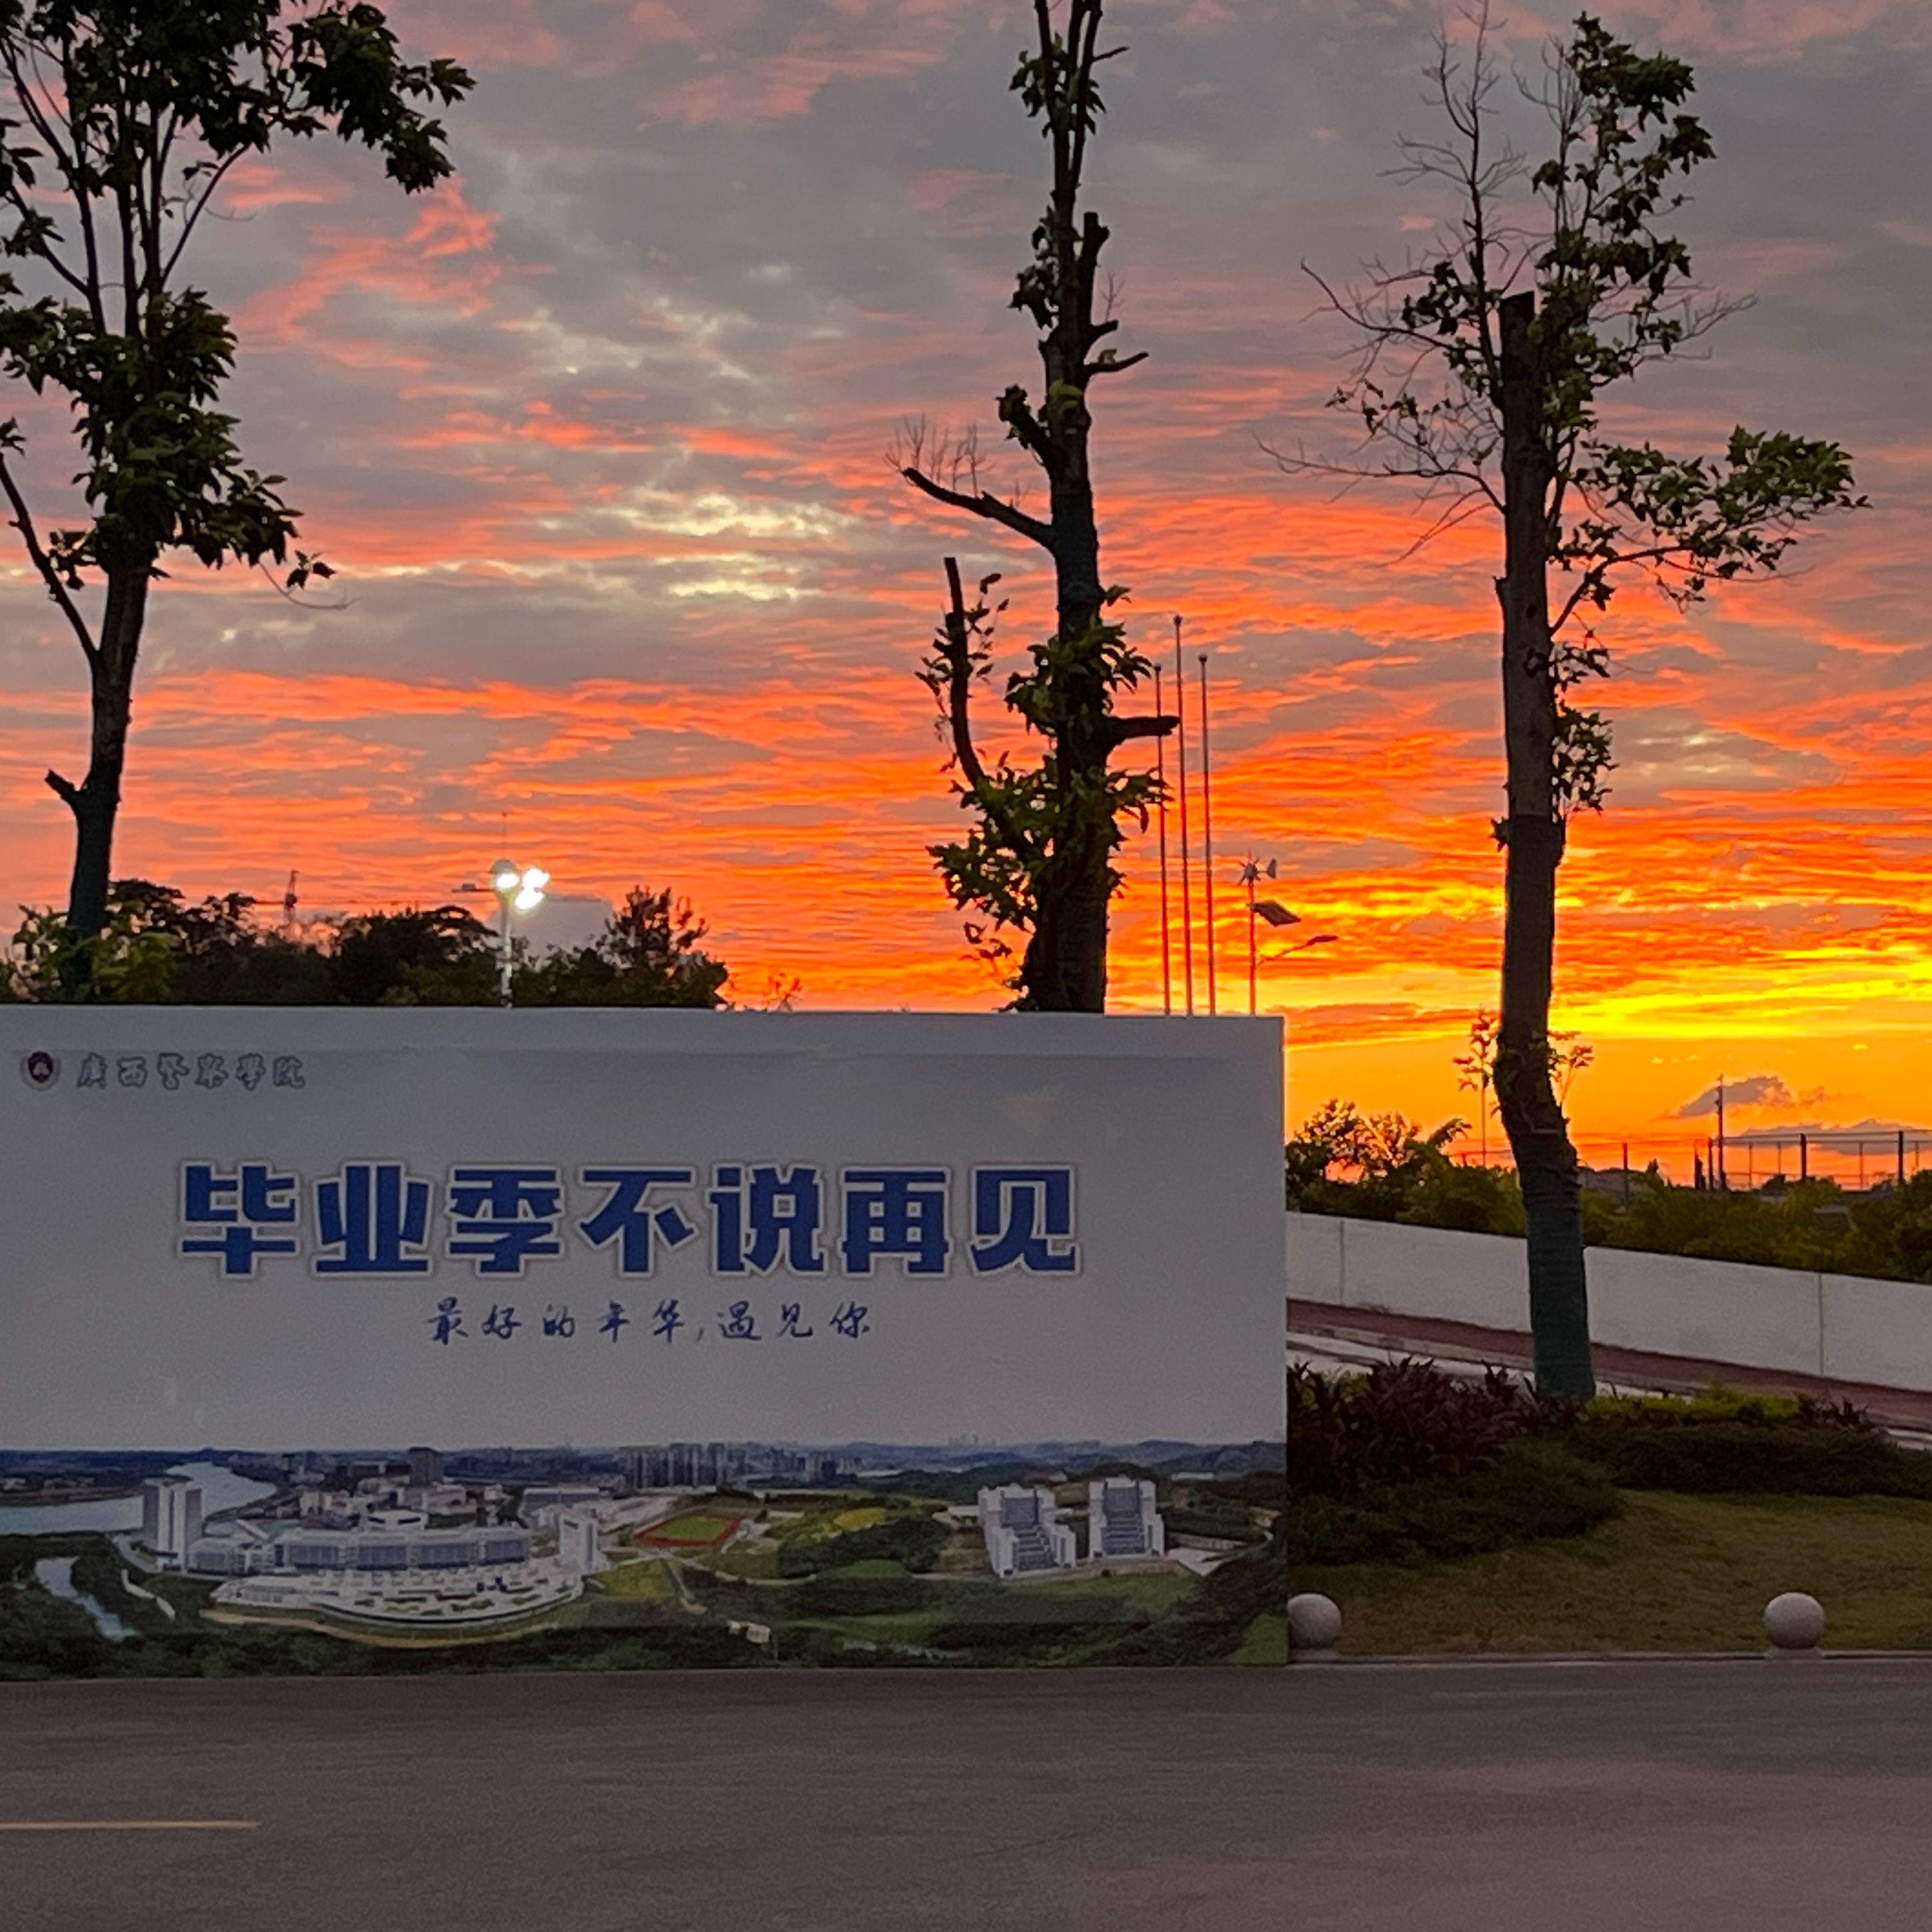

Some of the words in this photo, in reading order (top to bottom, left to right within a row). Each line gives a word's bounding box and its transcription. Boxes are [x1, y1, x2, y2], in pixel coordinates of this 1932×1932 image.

[180, 1164, 1077, 1275] 毕业季不说再见
